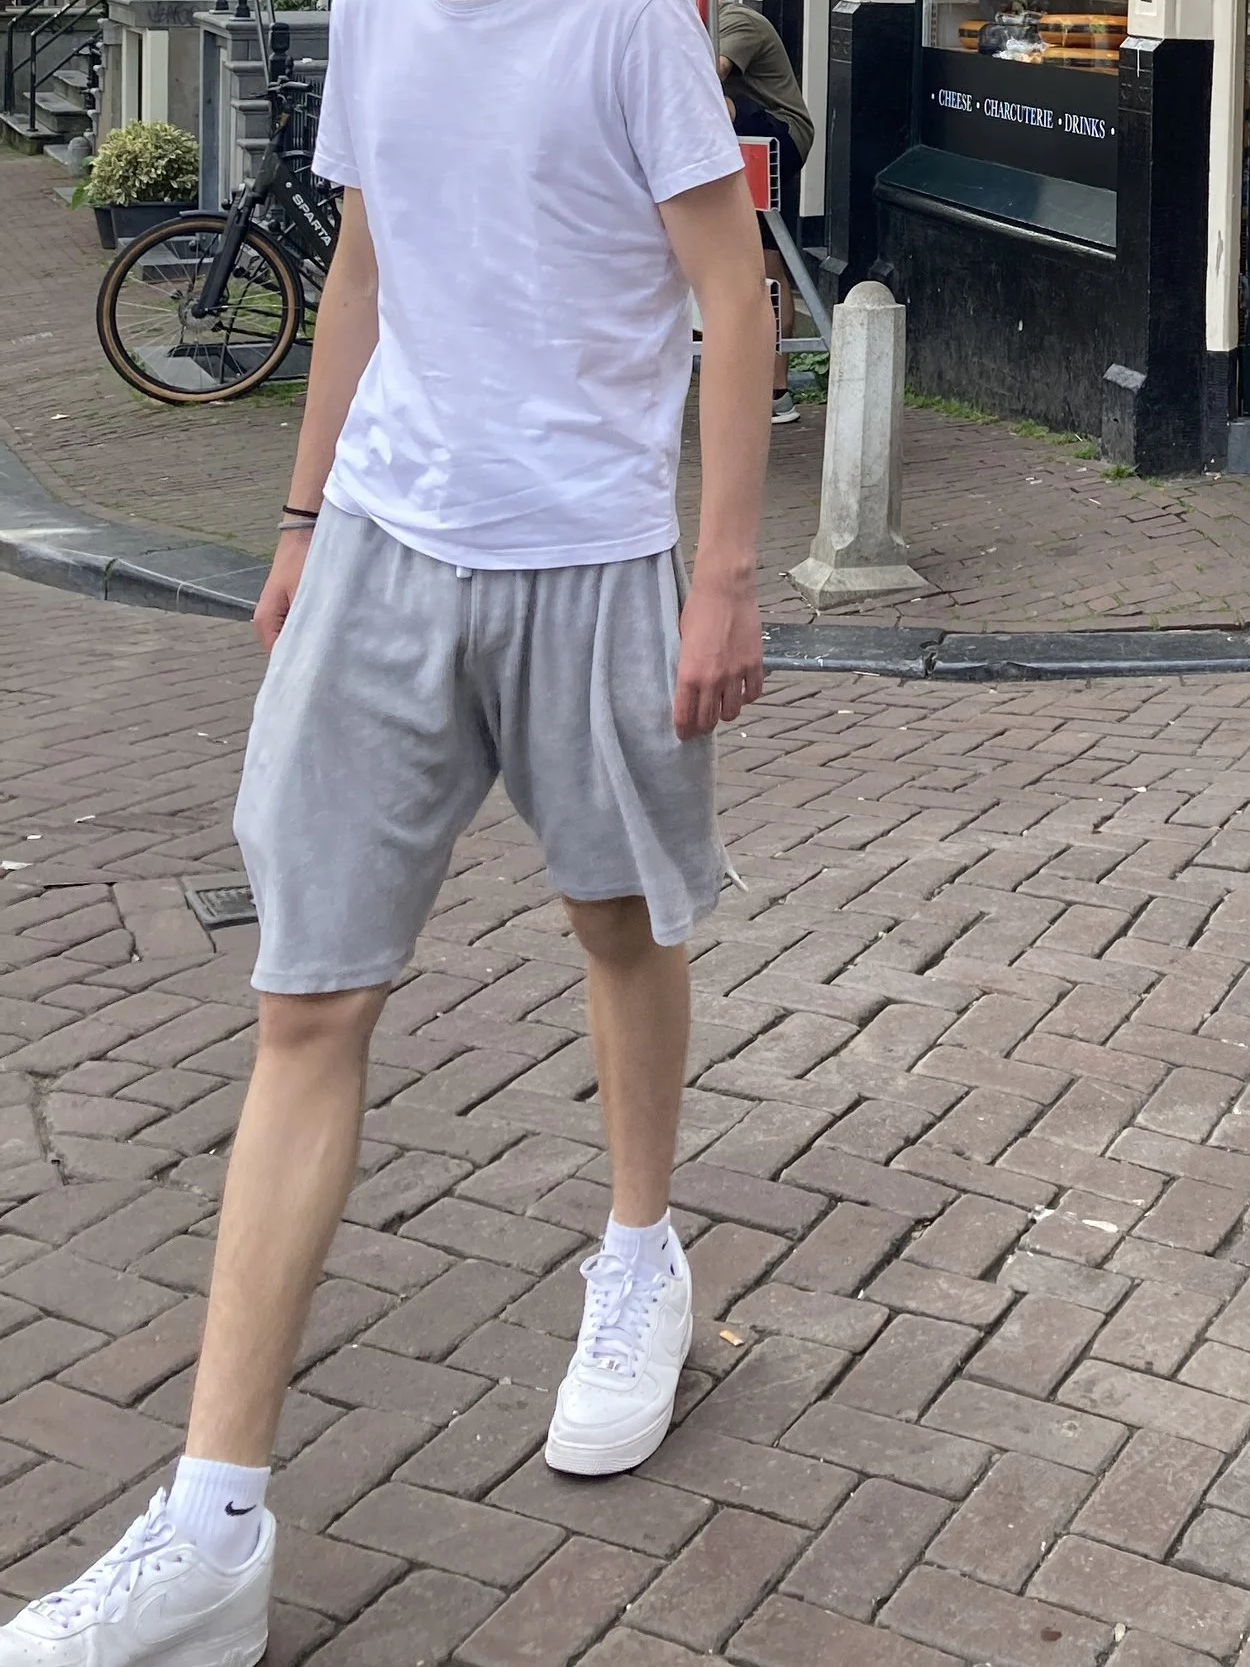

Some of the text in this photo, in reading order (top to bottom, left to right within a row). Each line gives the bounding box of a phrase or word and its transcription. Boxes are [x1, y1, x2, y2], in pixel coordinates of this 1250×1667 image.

[938, 88, 1106, 139] CHEESE CHARCUTERIE DRINKS
[292, 194, 332, 246] SPARTA
